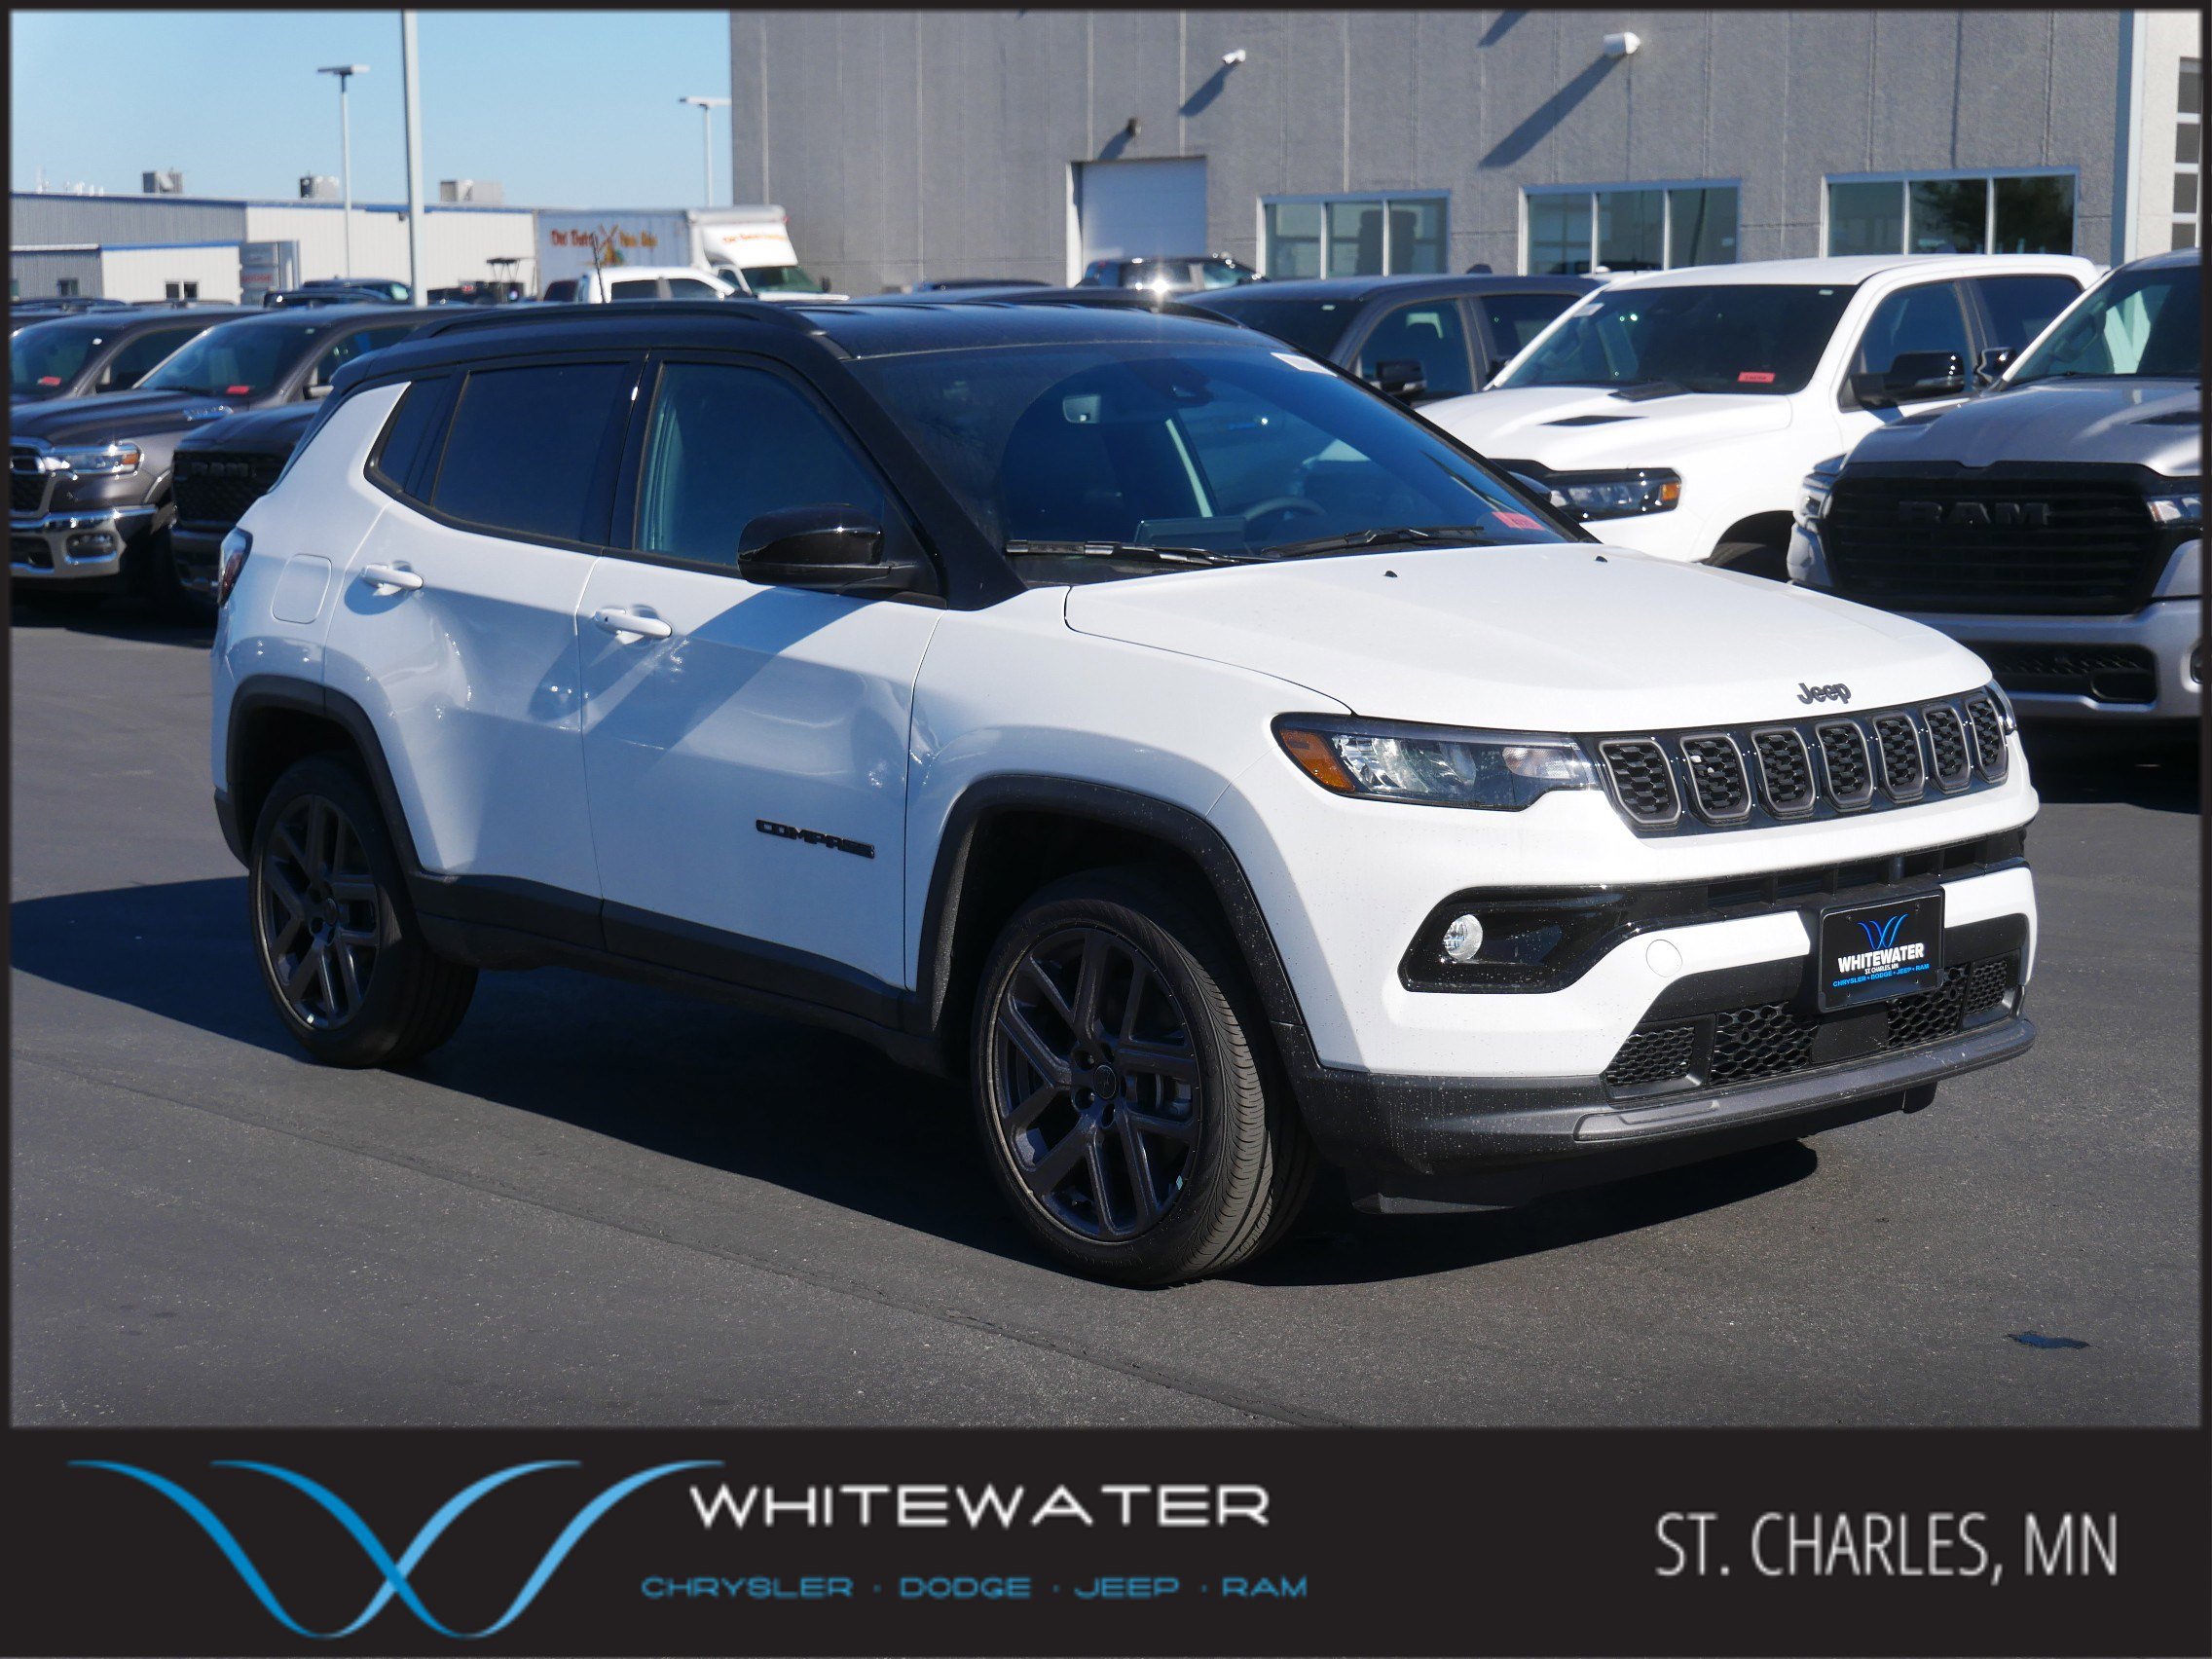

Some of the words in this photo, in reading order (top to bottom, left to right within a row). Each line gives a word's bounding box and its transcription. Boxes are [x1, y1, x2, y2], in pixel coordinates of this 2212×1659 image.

[1898, 500, 2050, 527] RAM
[1796, 682, 1852, 705] Jeep
[756, 819, 875, 860] COMPASS
[1837, 941, 1925, 974] WHITEWATER
[1832, 976, 1866, 987] CHRYSLER
[1870, 971, 1893, 980] DODGE
[1896, 967, 1912, 976] JEEP
